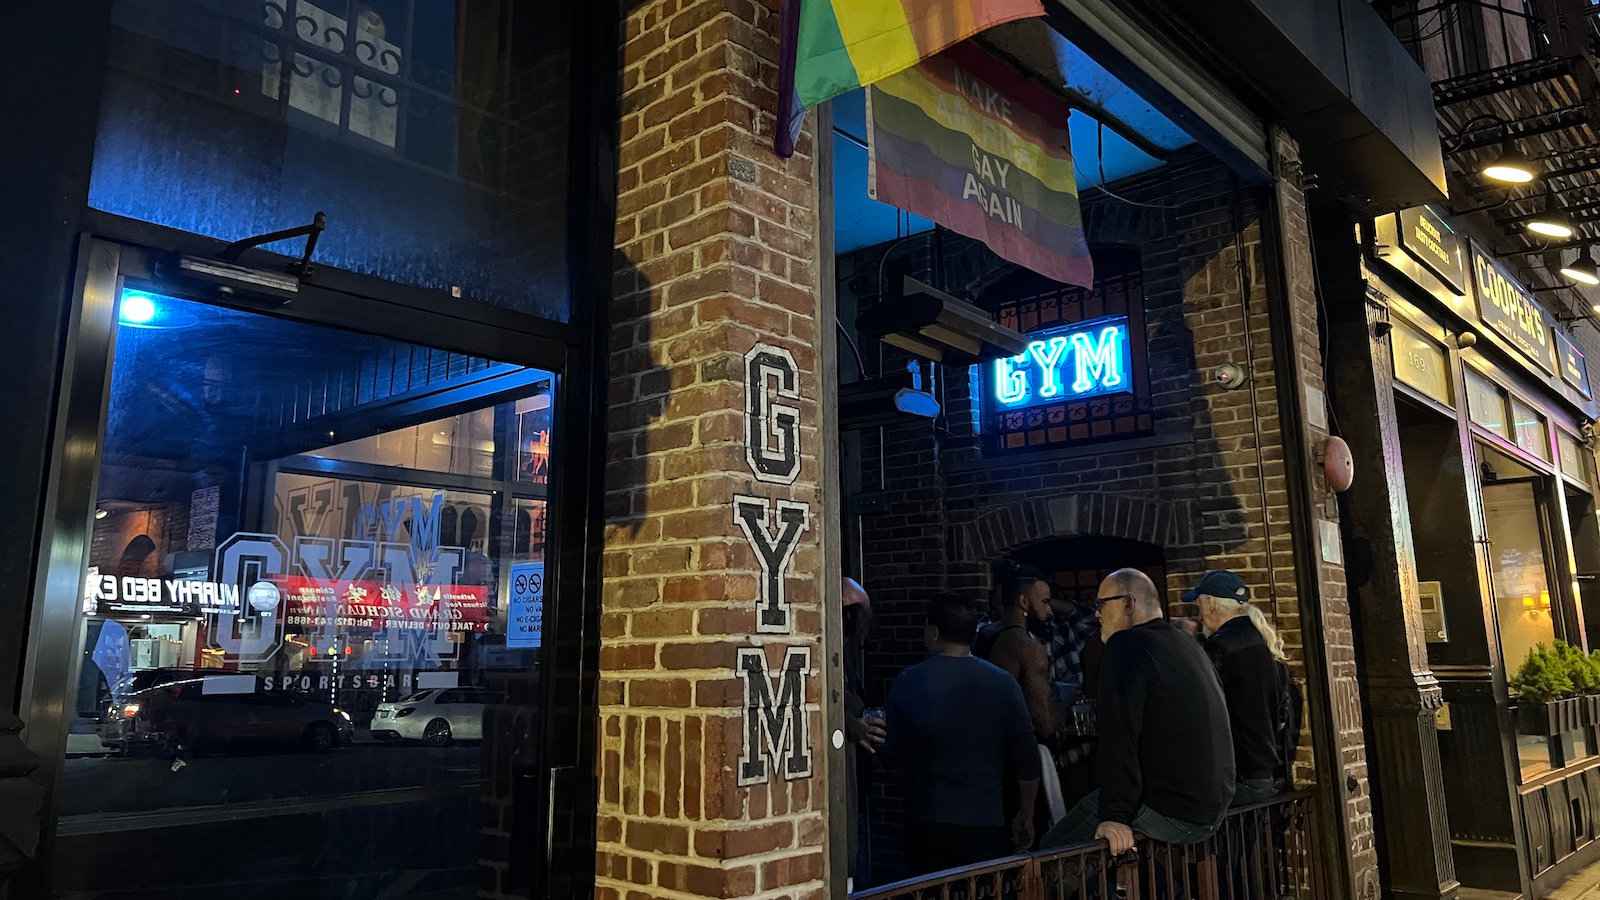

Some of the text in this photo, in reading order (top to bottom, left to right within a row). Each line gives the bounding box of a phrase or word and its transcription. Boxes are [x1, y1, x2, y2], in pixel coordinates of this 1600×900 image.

[954, 66, 1014, 126] MAKE
[969, 143, 1010, 189] GAY
[962, 172, 1023, 231] AGAIN
[995, 326, 1123, 404] GYM
[208, 532, 466, 662] GYM
[733, 342, 812, 787] GYM
